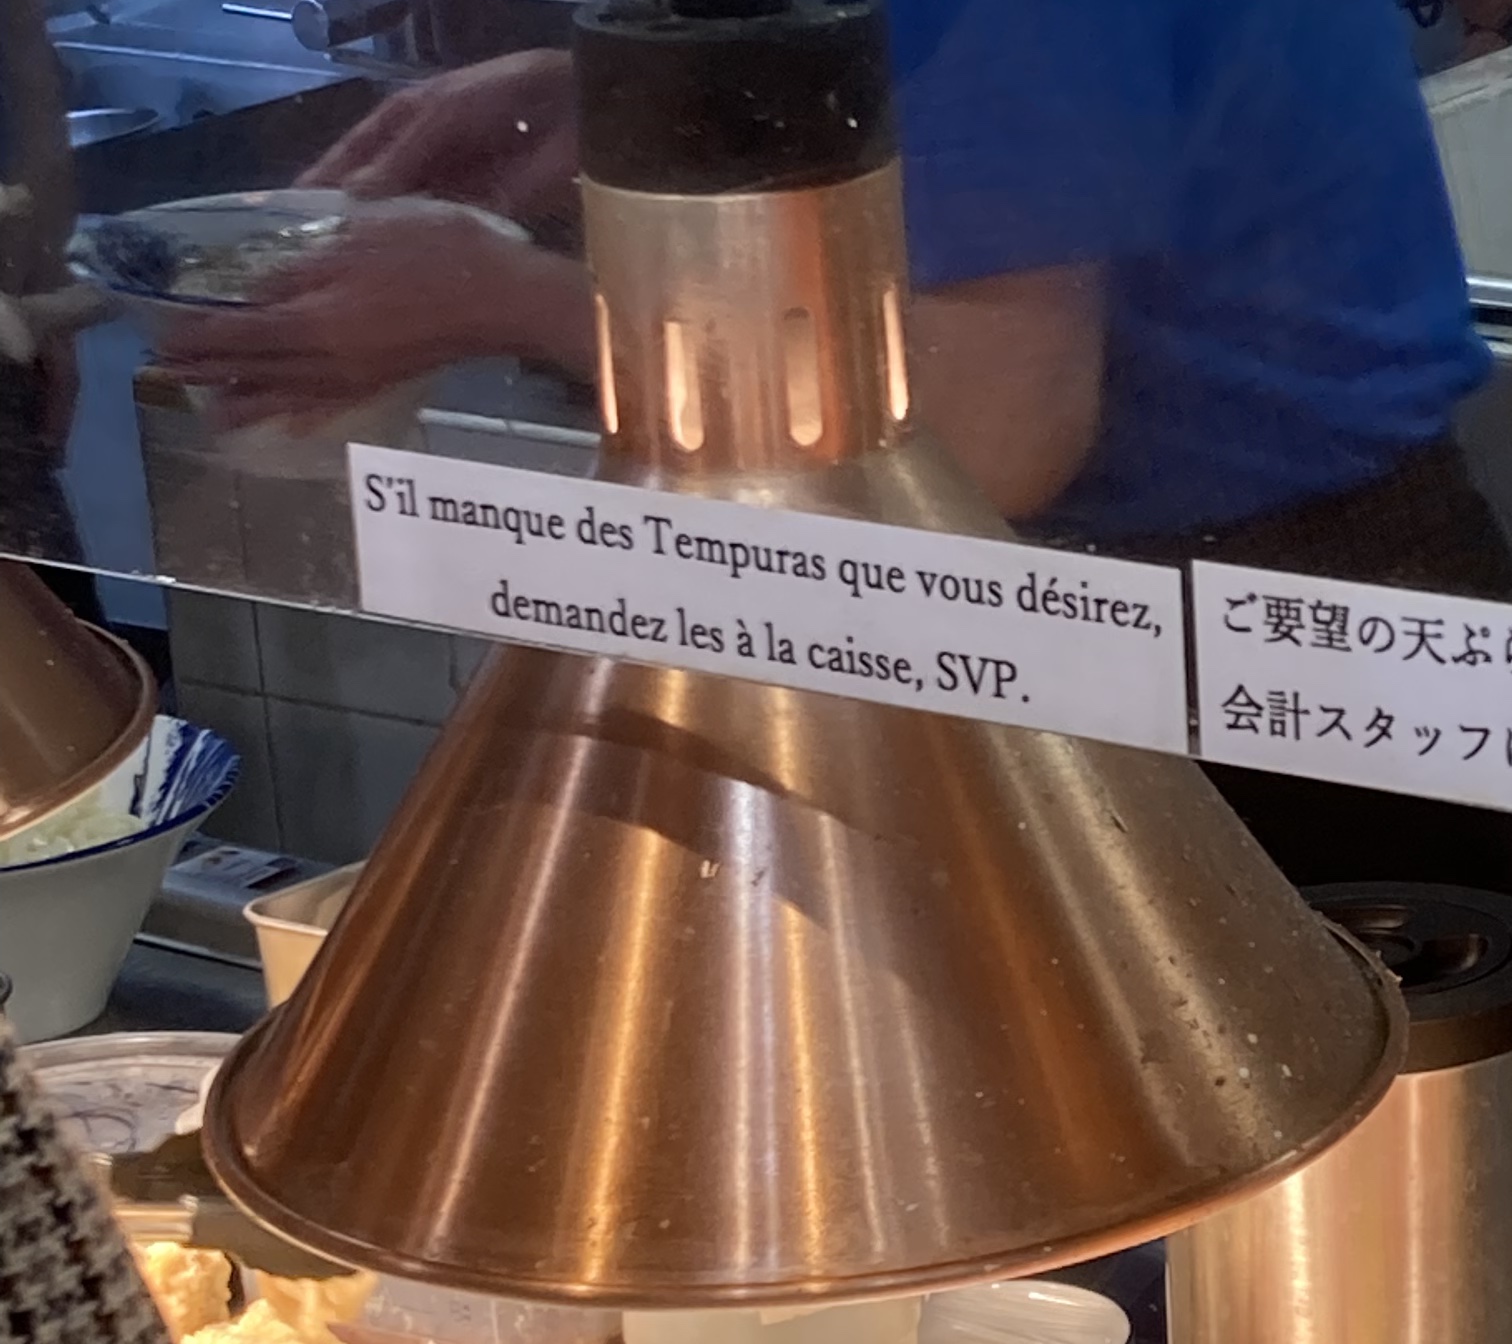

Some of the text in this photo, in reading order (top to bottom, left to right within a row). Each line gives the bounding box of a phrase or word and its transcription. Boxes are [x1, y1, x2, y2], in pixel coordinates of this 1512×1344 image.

[364, 473, 1164, 638] S'il manque des Tempuras que vous désirez,
[490, 580, 1032, 703] demandez les à la caisse, SVP.
